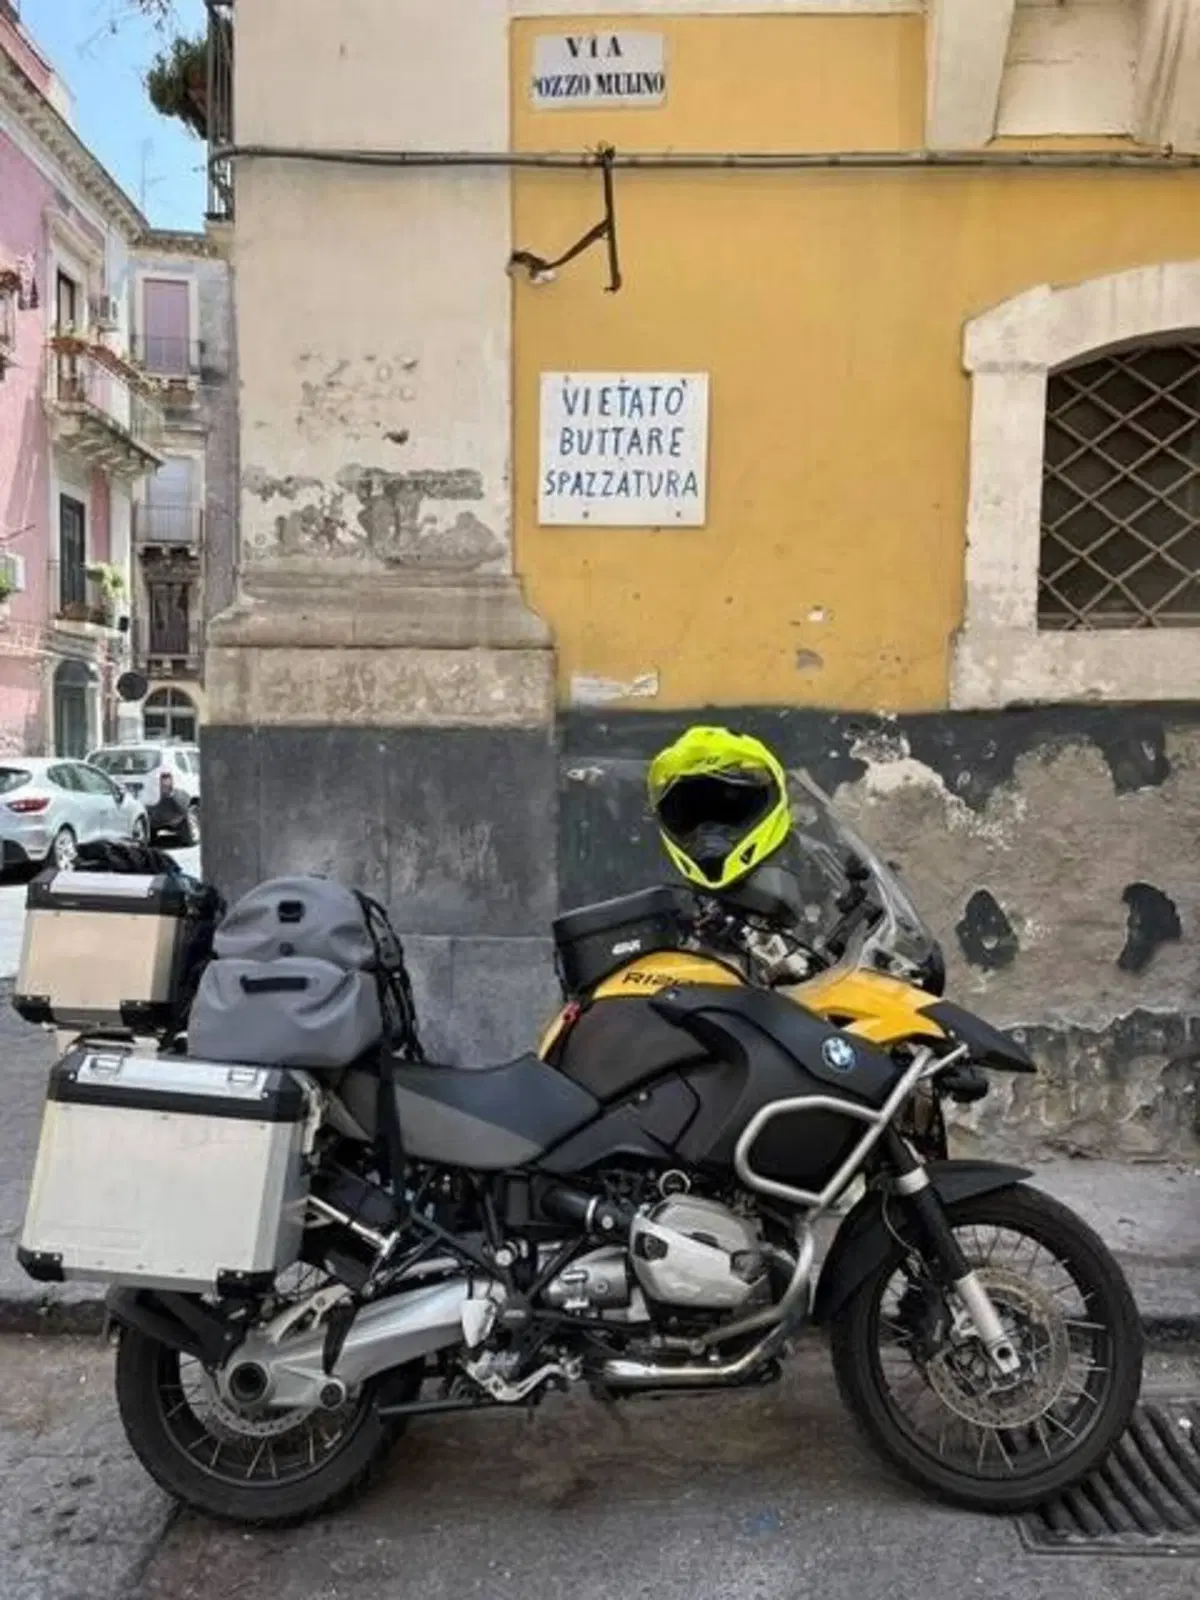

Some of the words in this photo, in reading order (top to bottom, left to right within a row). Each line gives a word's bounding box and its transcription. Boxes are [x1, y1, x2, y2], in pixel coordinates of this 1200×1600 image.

[565, 35, 623, 58] VIA
[595, 72, 666, 96] MULINO
[559, 426, 685, 457] BUTTARE
[543, 468, 699, 498] SPAZZATURA
